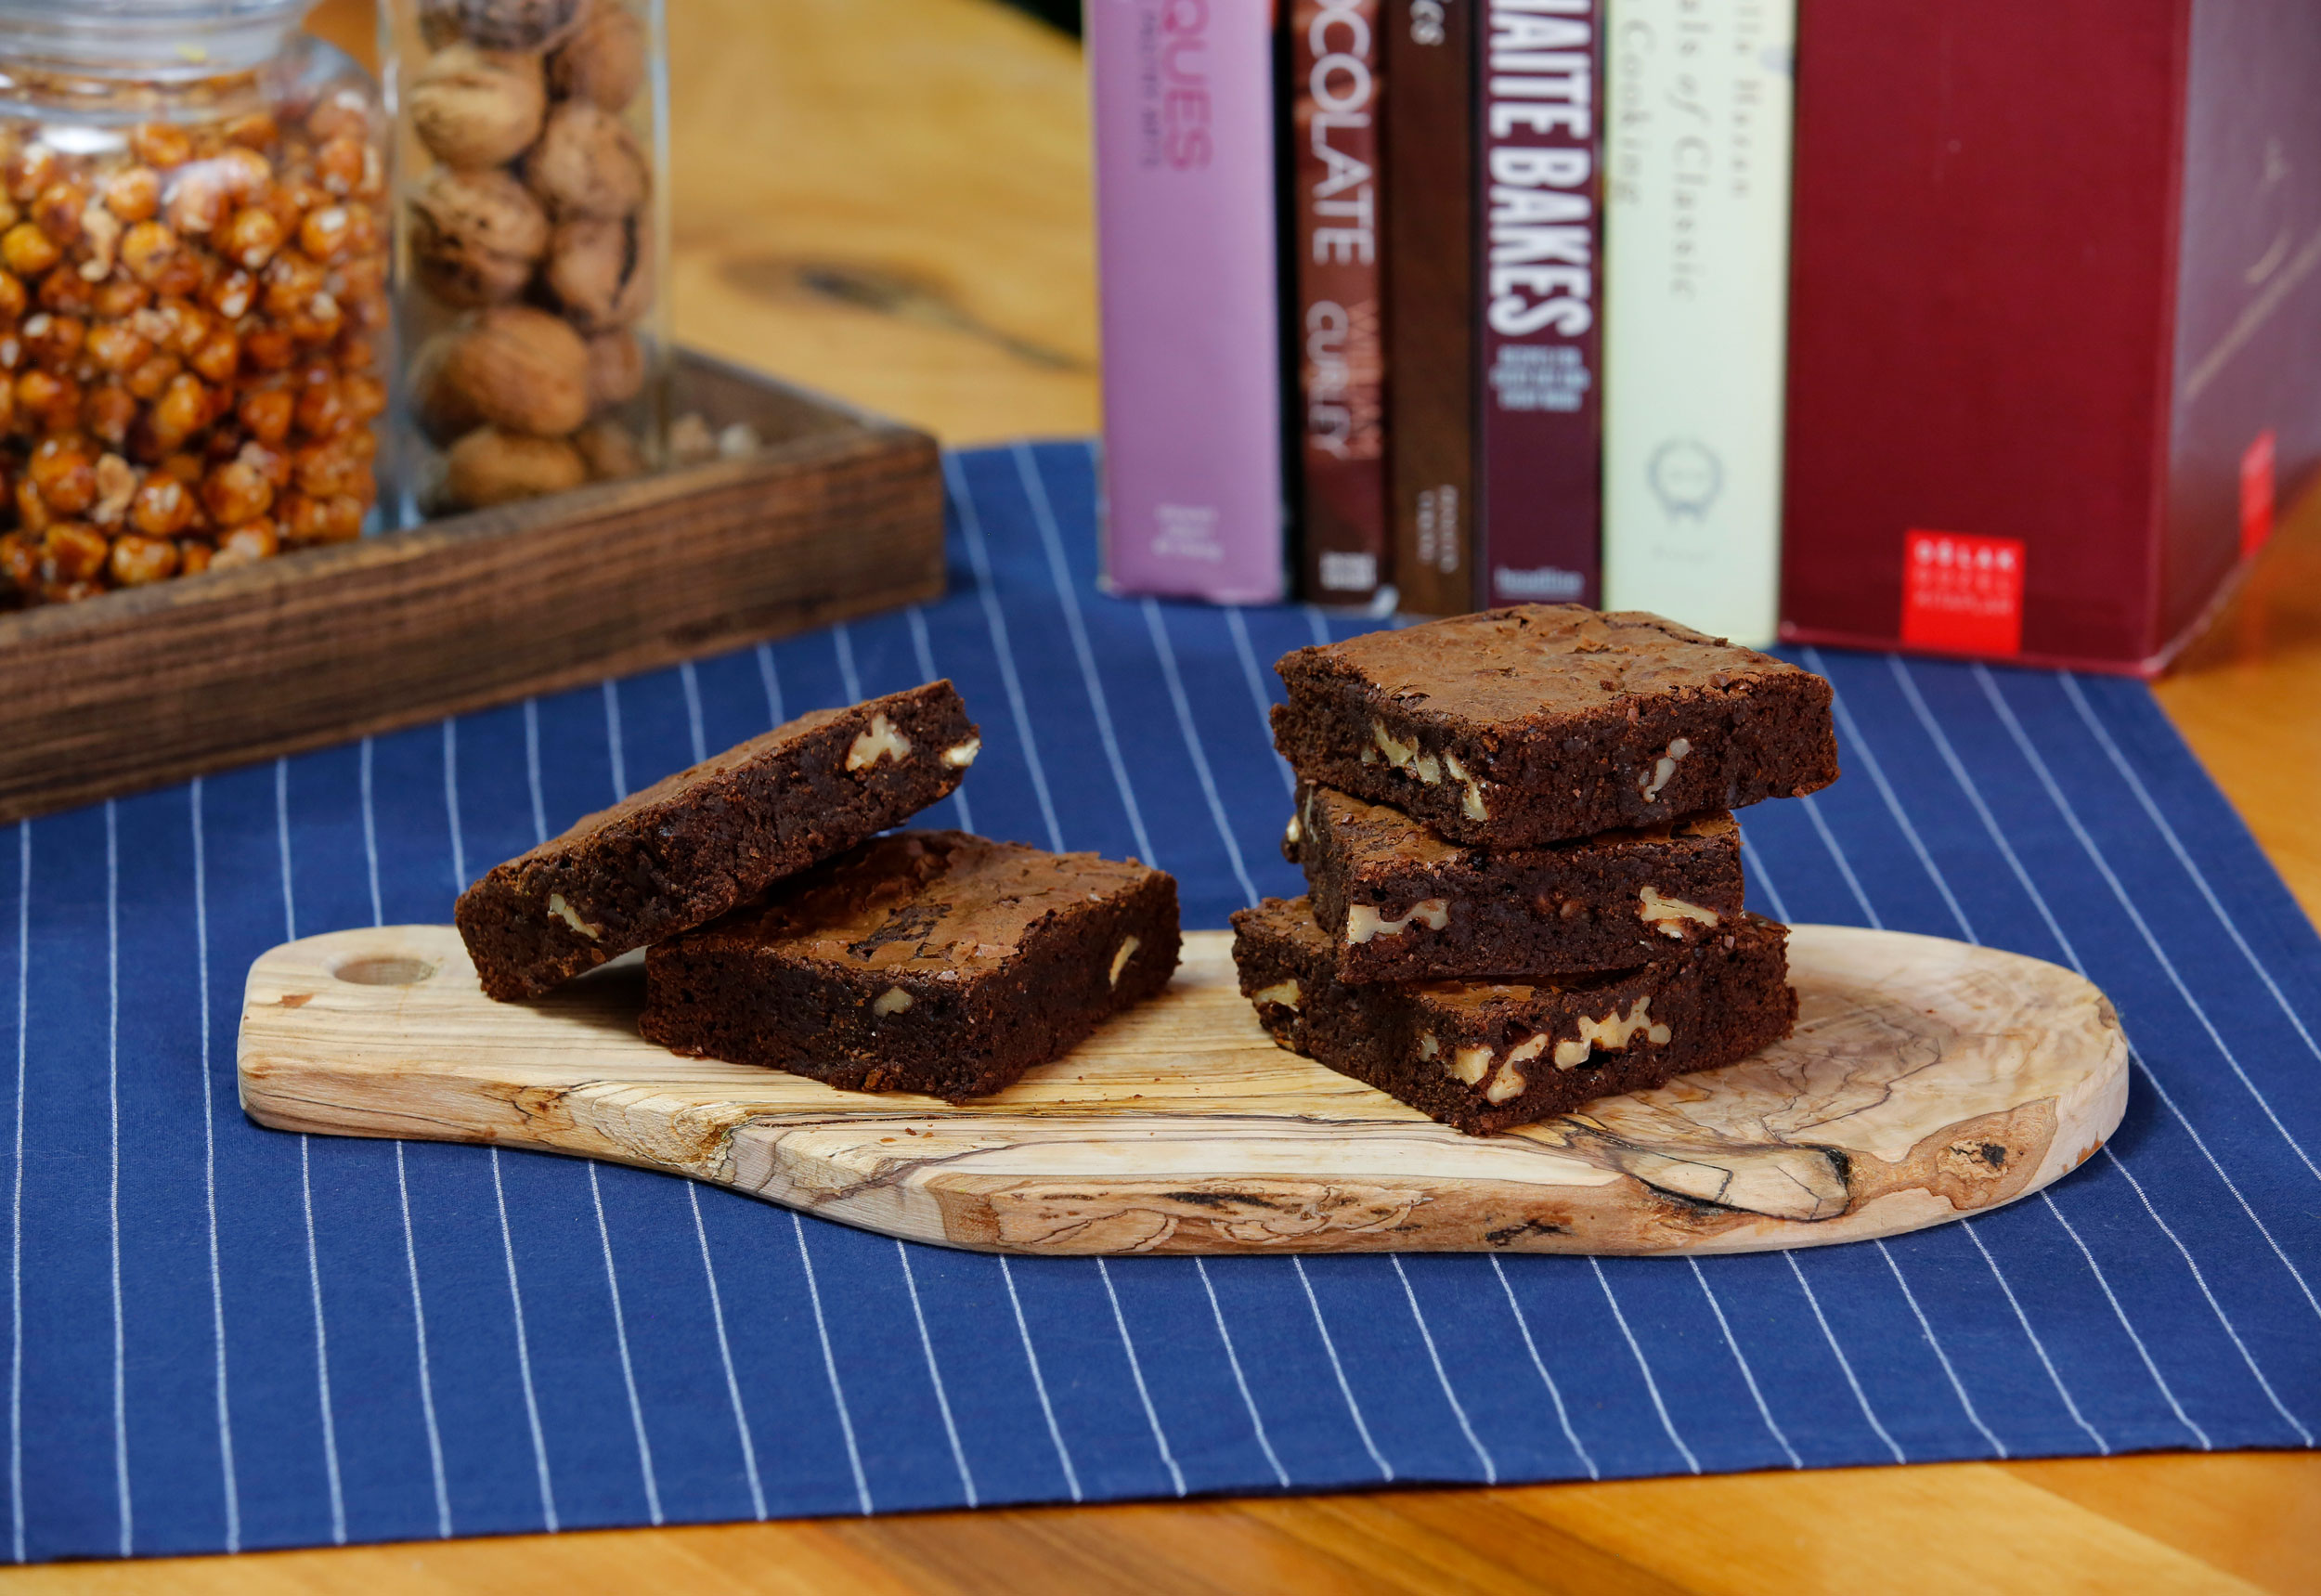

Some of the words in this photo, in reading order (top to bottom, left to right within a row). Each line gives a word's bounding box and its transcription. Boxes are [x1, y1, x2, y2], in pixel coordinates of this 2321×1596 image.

[1162, 0, 1213, 171] QUES
[1309, 0, 1376, 266] COLATE
[1609, 19, 1656, 206] Cooking
[1487, 146, 1593, 337] BAKES
[1670, 135, 1713, 302] Classic
